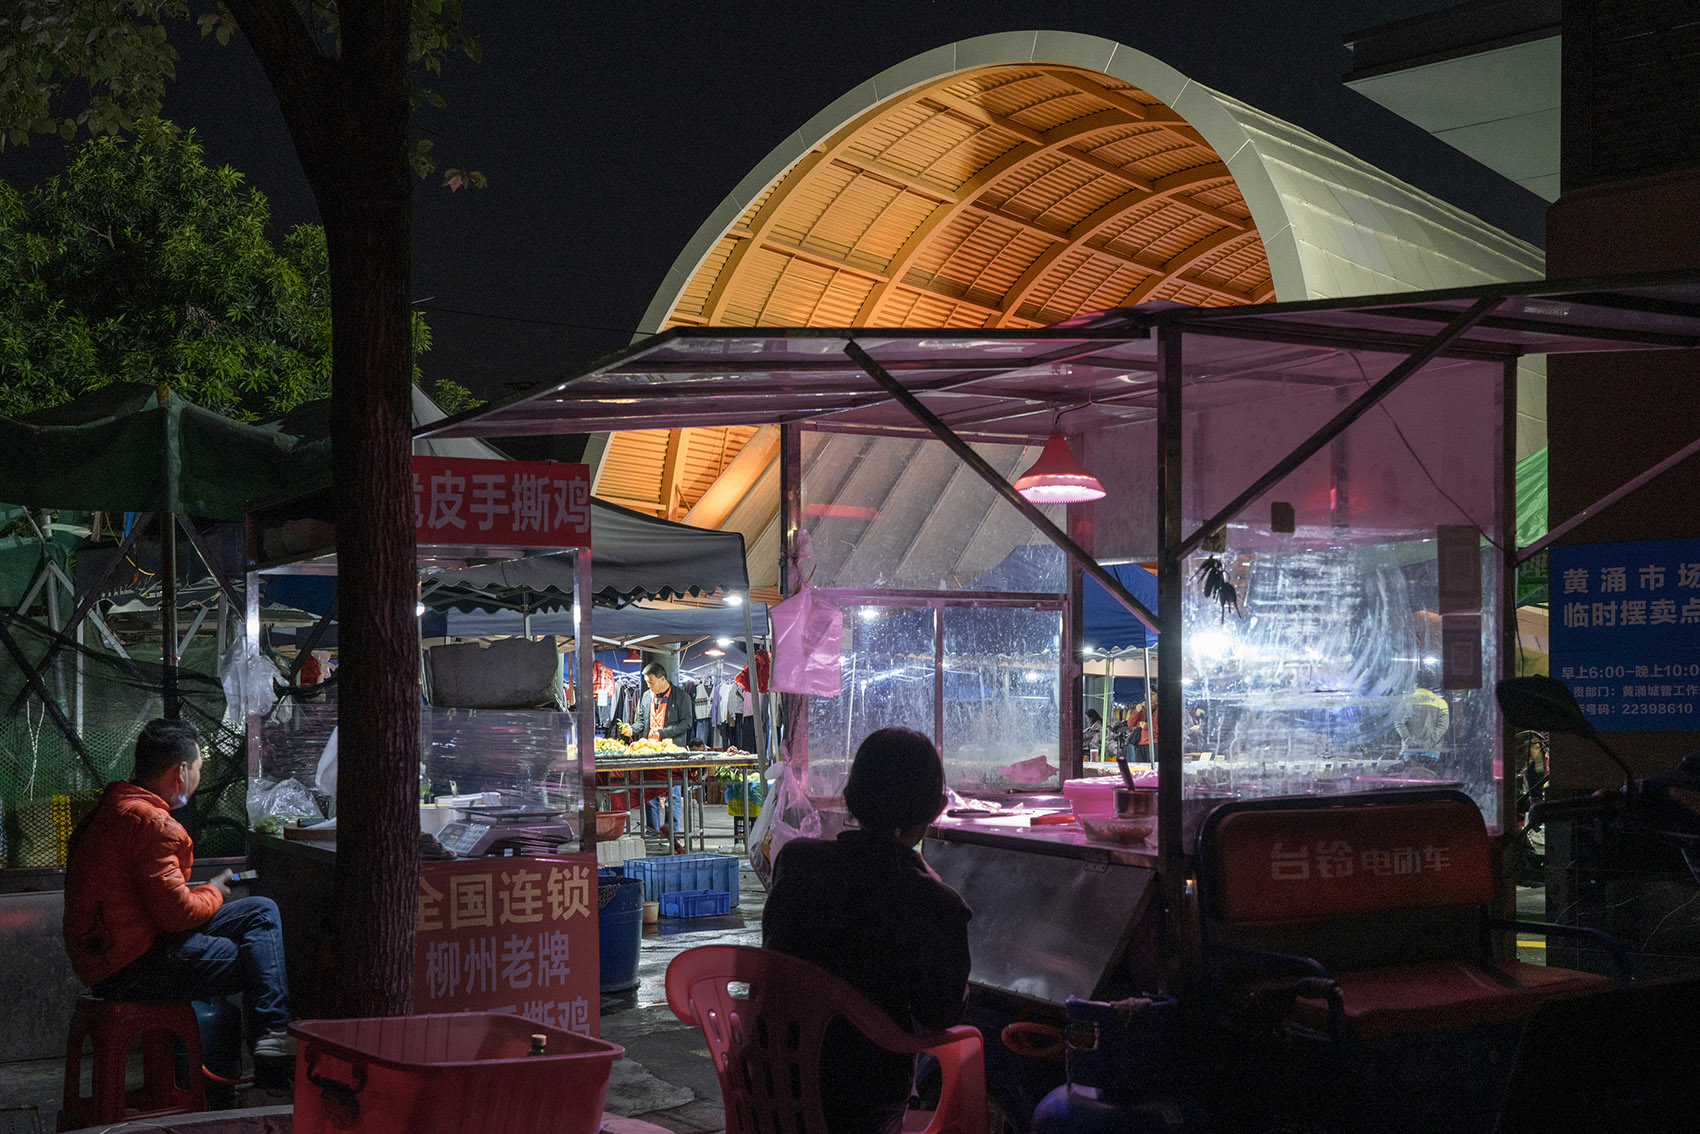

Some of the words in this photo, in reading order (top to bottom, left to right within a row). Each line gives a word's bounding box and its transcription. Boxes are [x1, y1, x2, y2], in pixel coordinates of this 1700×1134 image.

[1563, 562, 1700, 594] 黄涌市场
[1563, 598, 1700, 628] 临时摆卖点
[416, 865, 591, 931] 全国连锁
[426, 930, 570, 999] 柳州老牌
